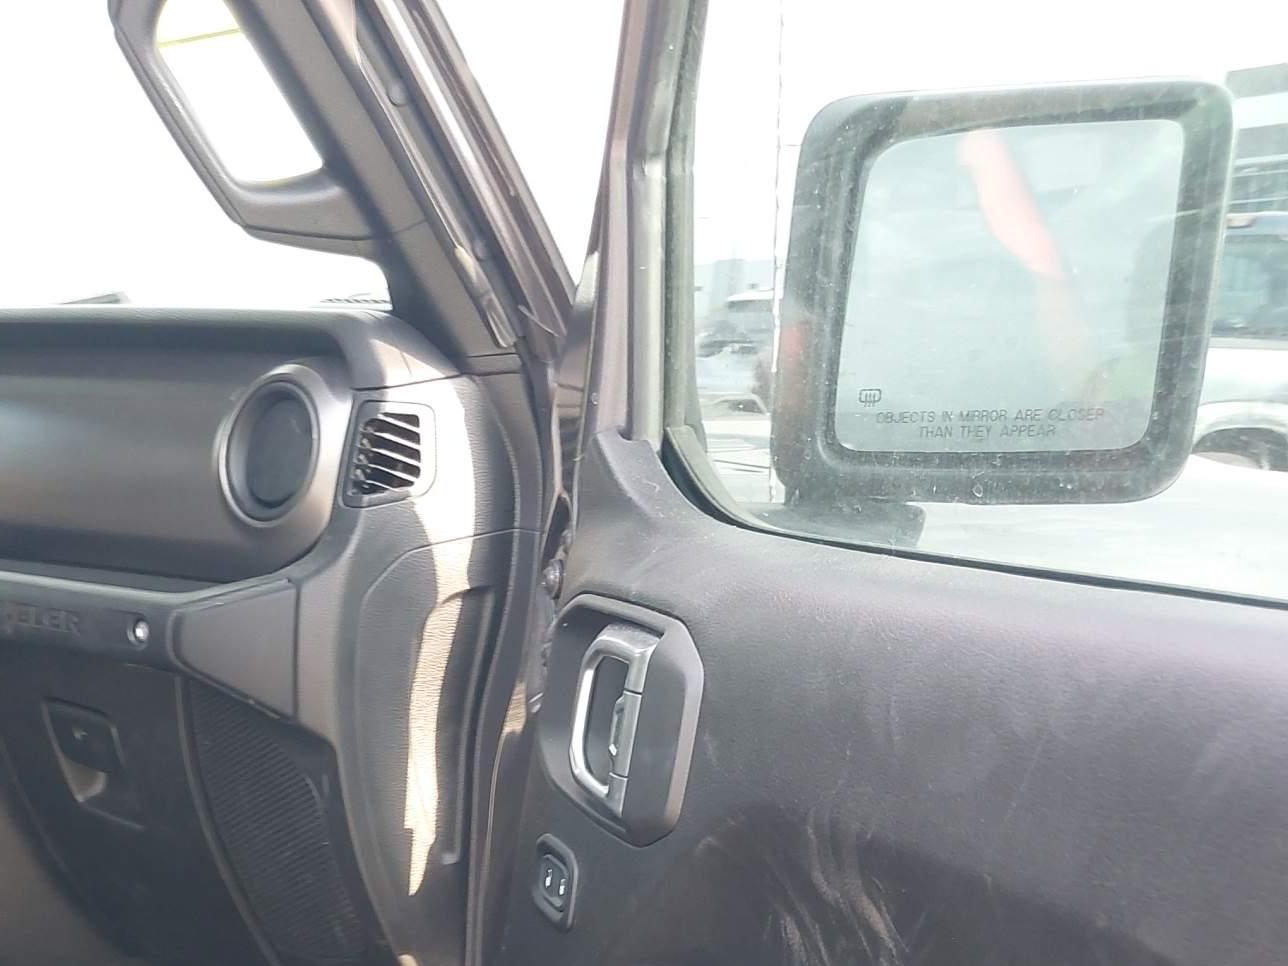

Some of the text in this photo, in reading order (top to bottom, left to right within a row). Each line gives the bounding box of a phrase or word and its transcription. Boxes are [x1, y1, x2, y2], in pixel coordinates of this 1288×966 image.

[876, 410, 936, 424] OBJECTS
[942, 410, 953, 422] IN
[959, 409, 1009, 422] MIRROR
[1014, 408, 1042, 421] ARE
[919, 424, 1057, 438] THAN THEY APPEAR
